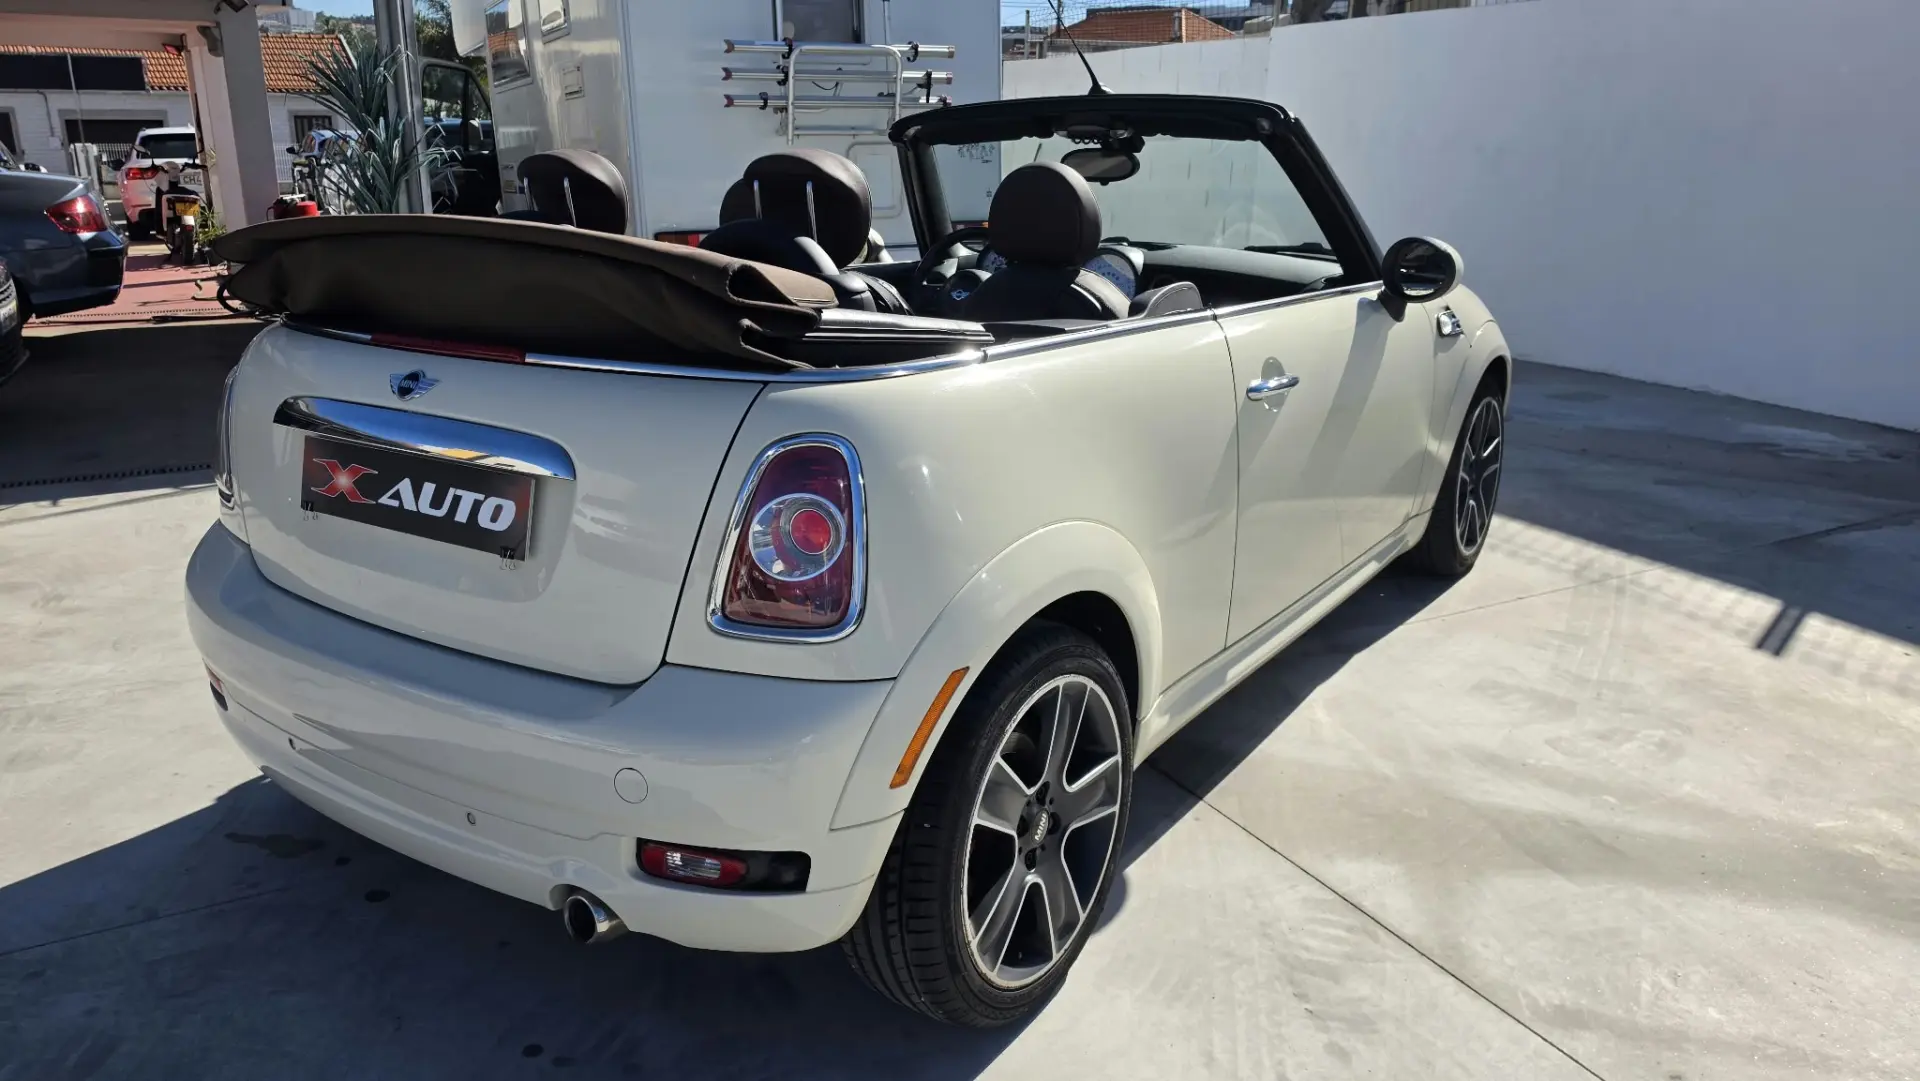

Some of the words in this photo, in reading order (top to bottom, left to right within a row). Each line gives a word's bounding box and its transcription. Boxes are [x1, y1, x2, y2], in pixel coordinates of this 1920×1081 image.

[400, 379, 418, 389] MINI
[377, 477, 517, 532] AUTO
[1034, 813, 1048, 841] MINI
